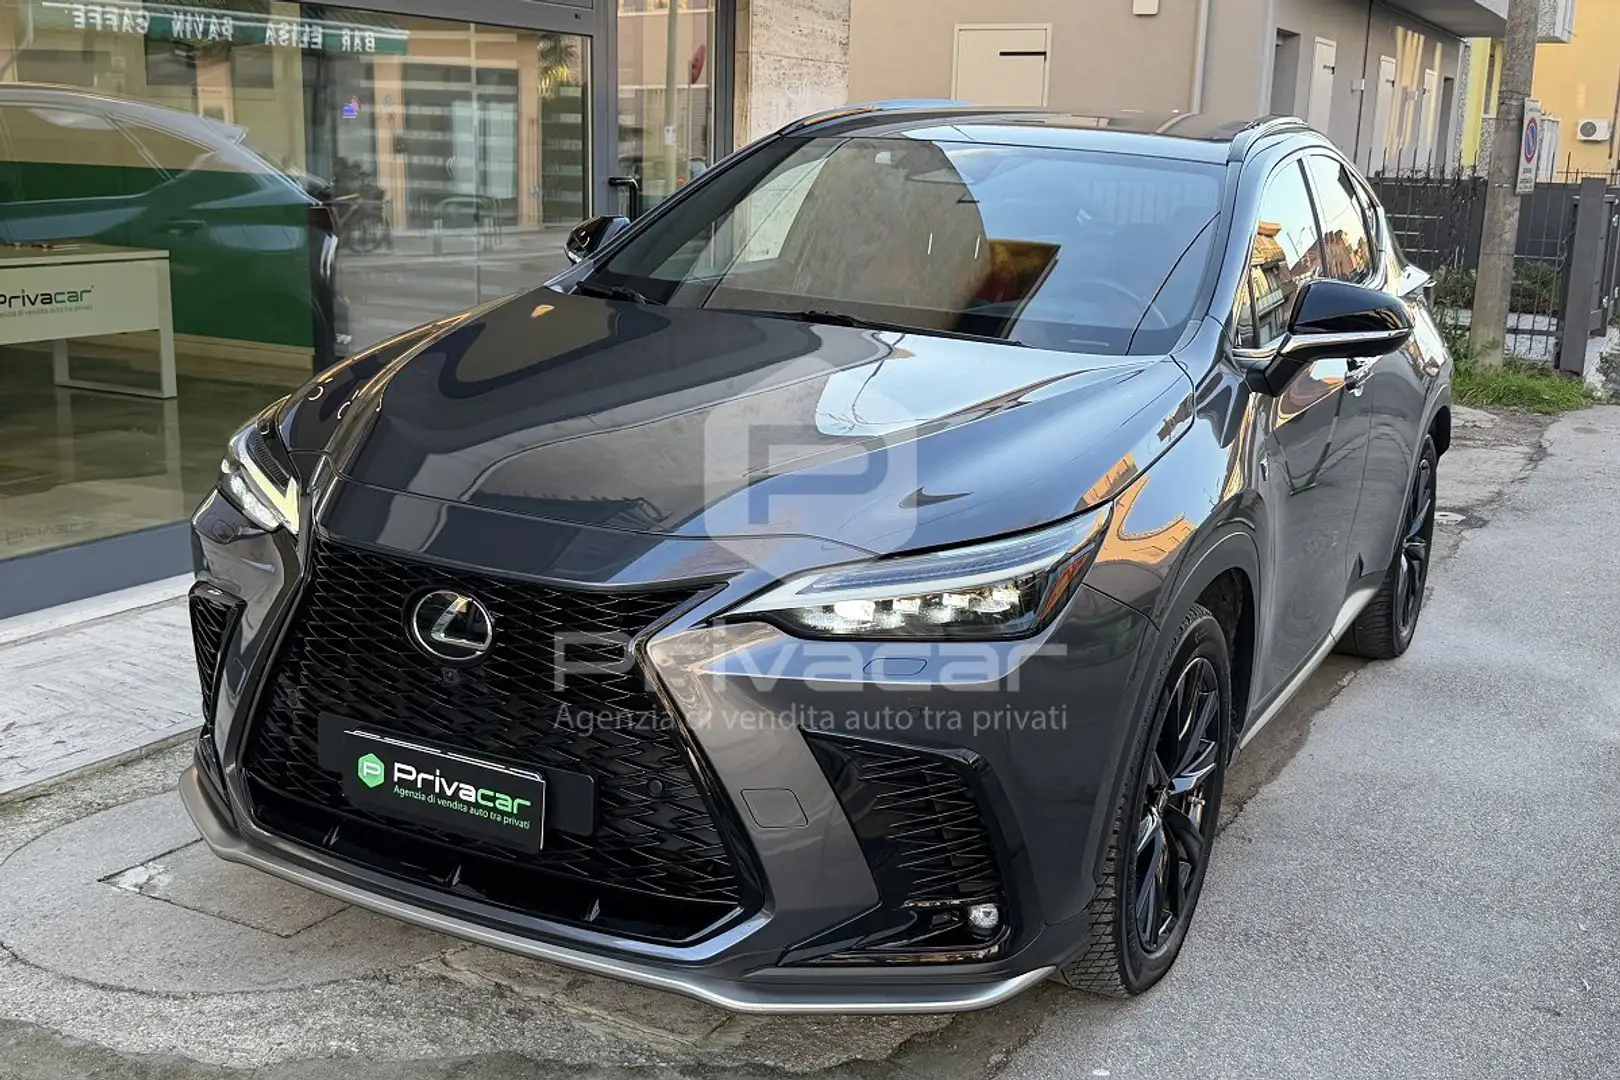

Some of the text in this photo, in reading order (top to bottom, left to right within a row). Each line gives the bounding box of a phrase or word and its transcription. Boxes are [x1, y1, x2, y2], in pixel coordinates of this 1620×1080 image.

[393, 762, 531, 814] Privacar
[393, 784, 531, 830] Agenzia di vendita auto tra privati
